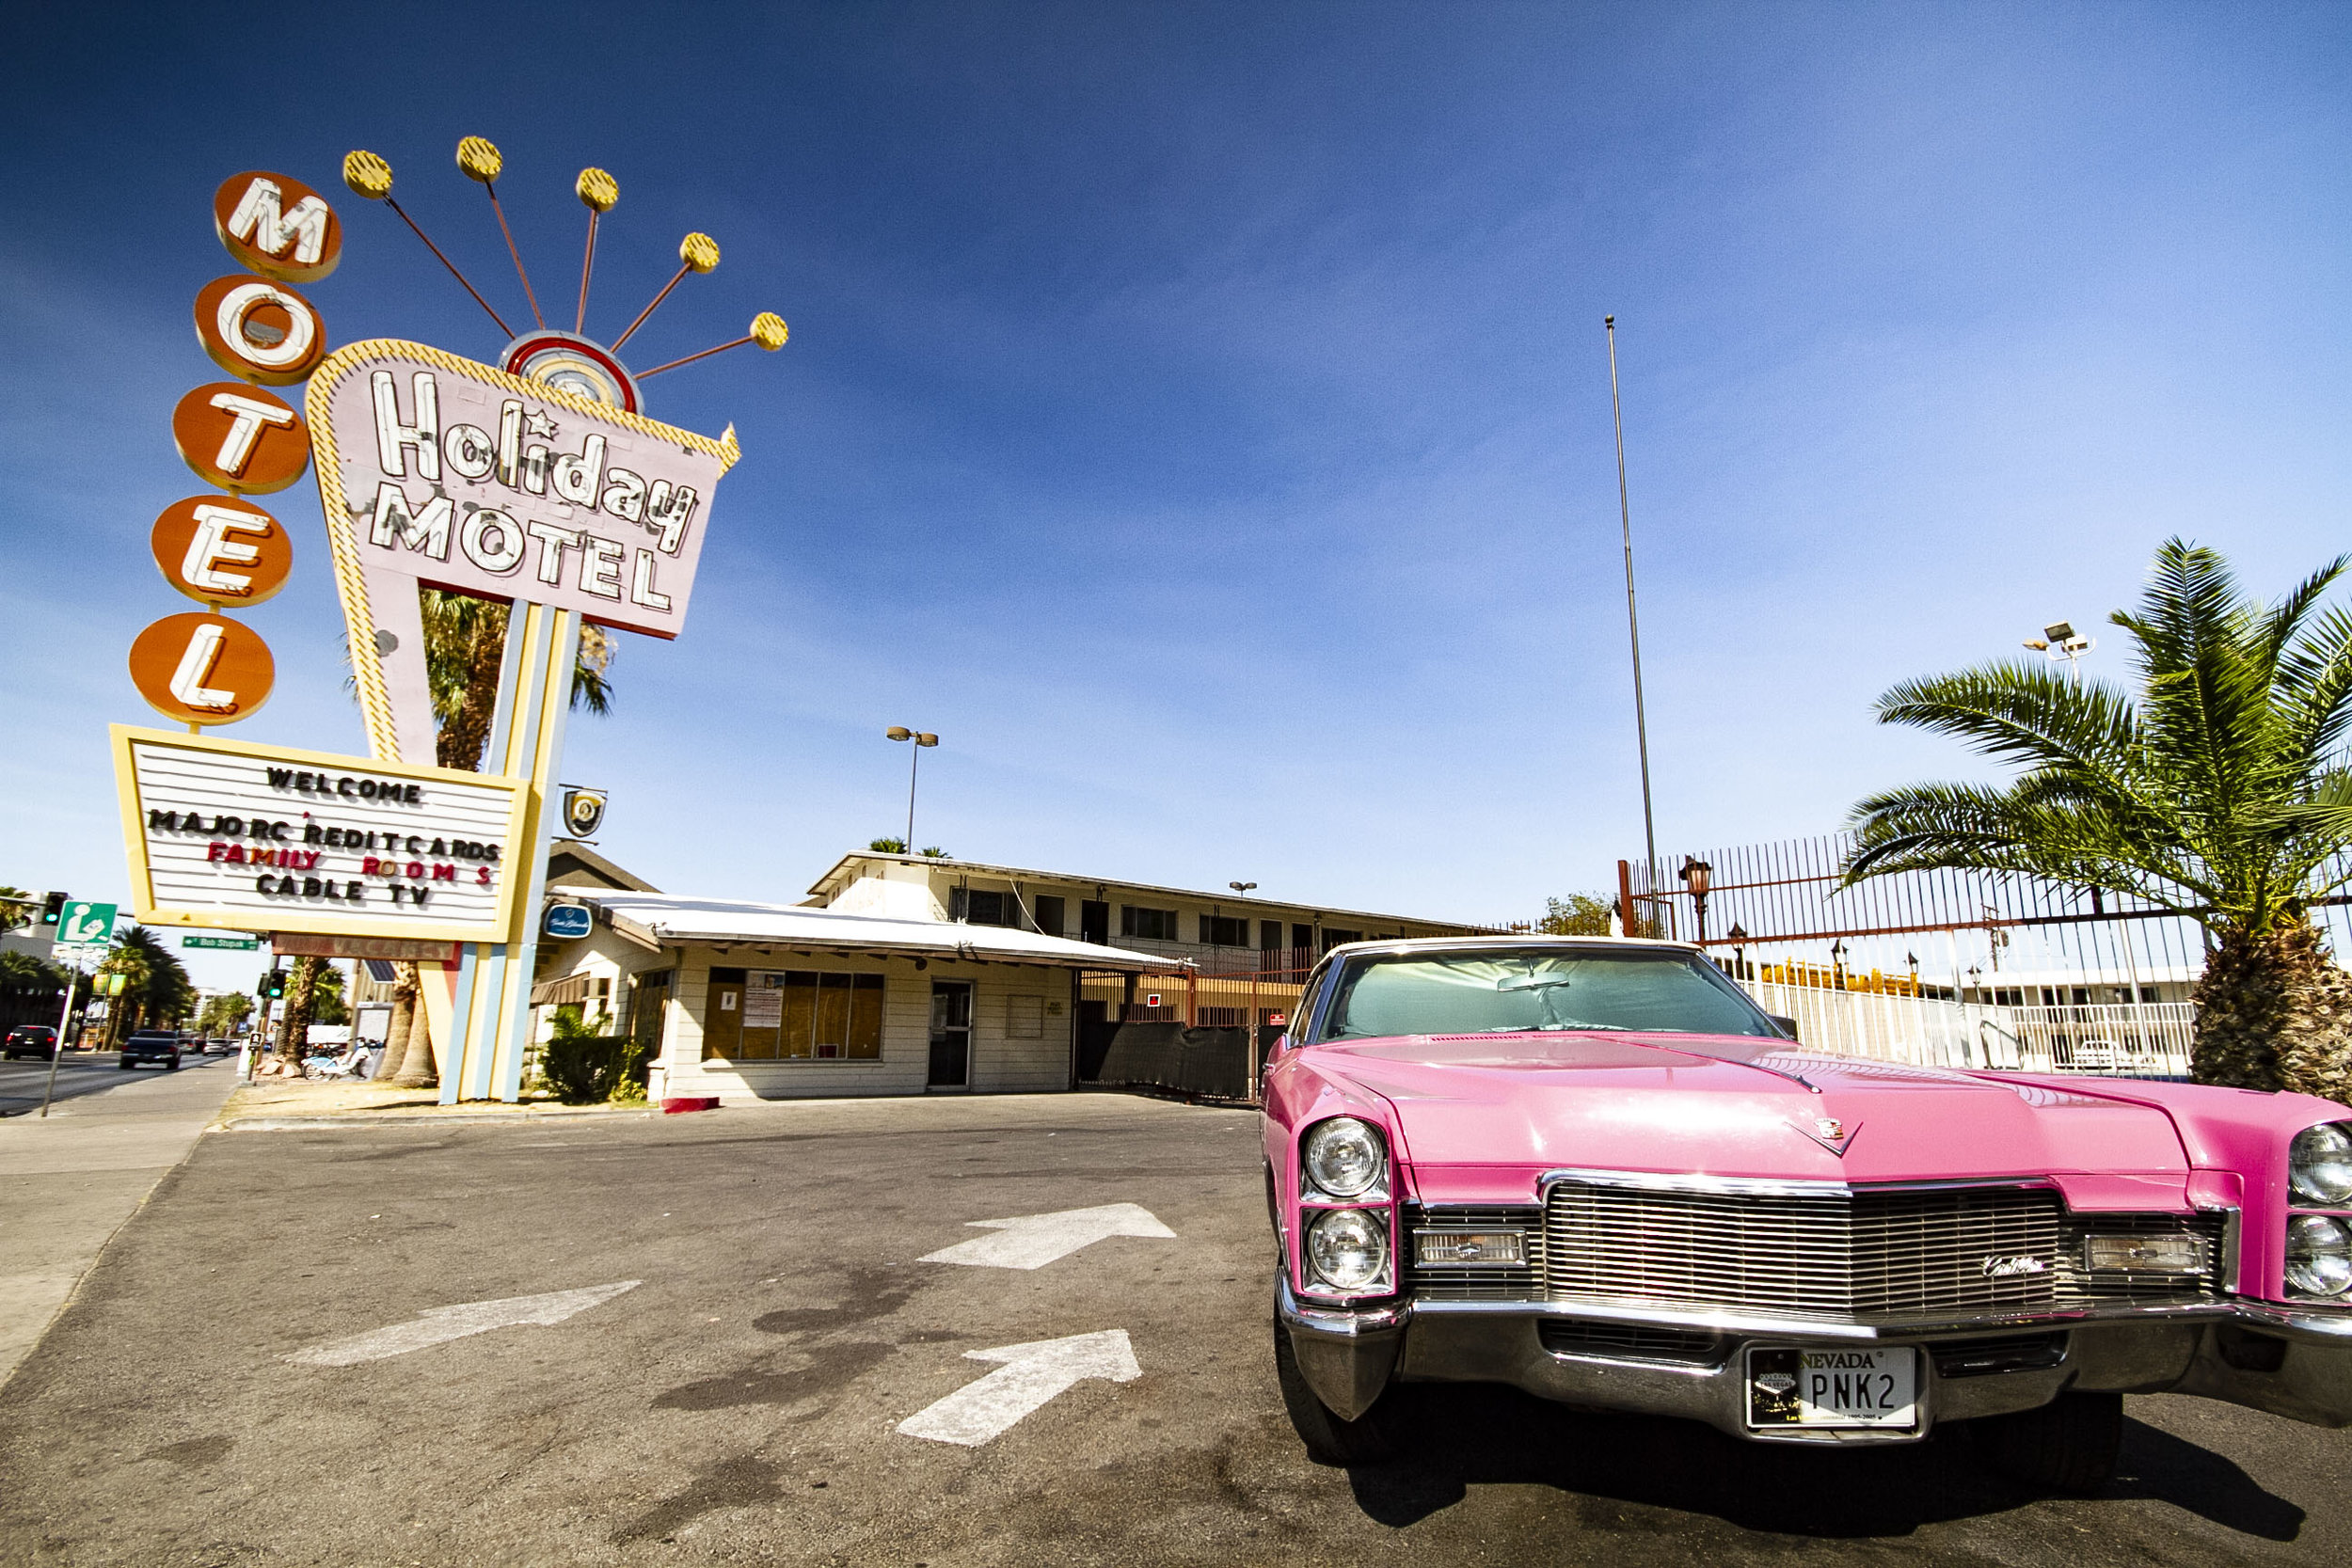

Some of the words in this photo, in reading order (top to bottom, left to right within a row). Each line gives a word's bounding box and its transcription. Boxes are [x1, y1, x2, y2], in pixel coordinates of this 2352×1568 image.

[170, 177, 328, 708] MOTEL
[371, 370, 697, 553] Holiday
[369, 481, 672, 611] MOTEL
[266, 767, 421, 803] WELCOME
[207, 842, 321, 870] FAMILY
[256, 874, 363, 900] CABLE
[388, 883, 429, 904] TV
[217, 939, 244, 949] Stupak
[1800, 1353, 1875, 1370] NEVADA
[1812, 1374, 1895, 1410] PNK2
